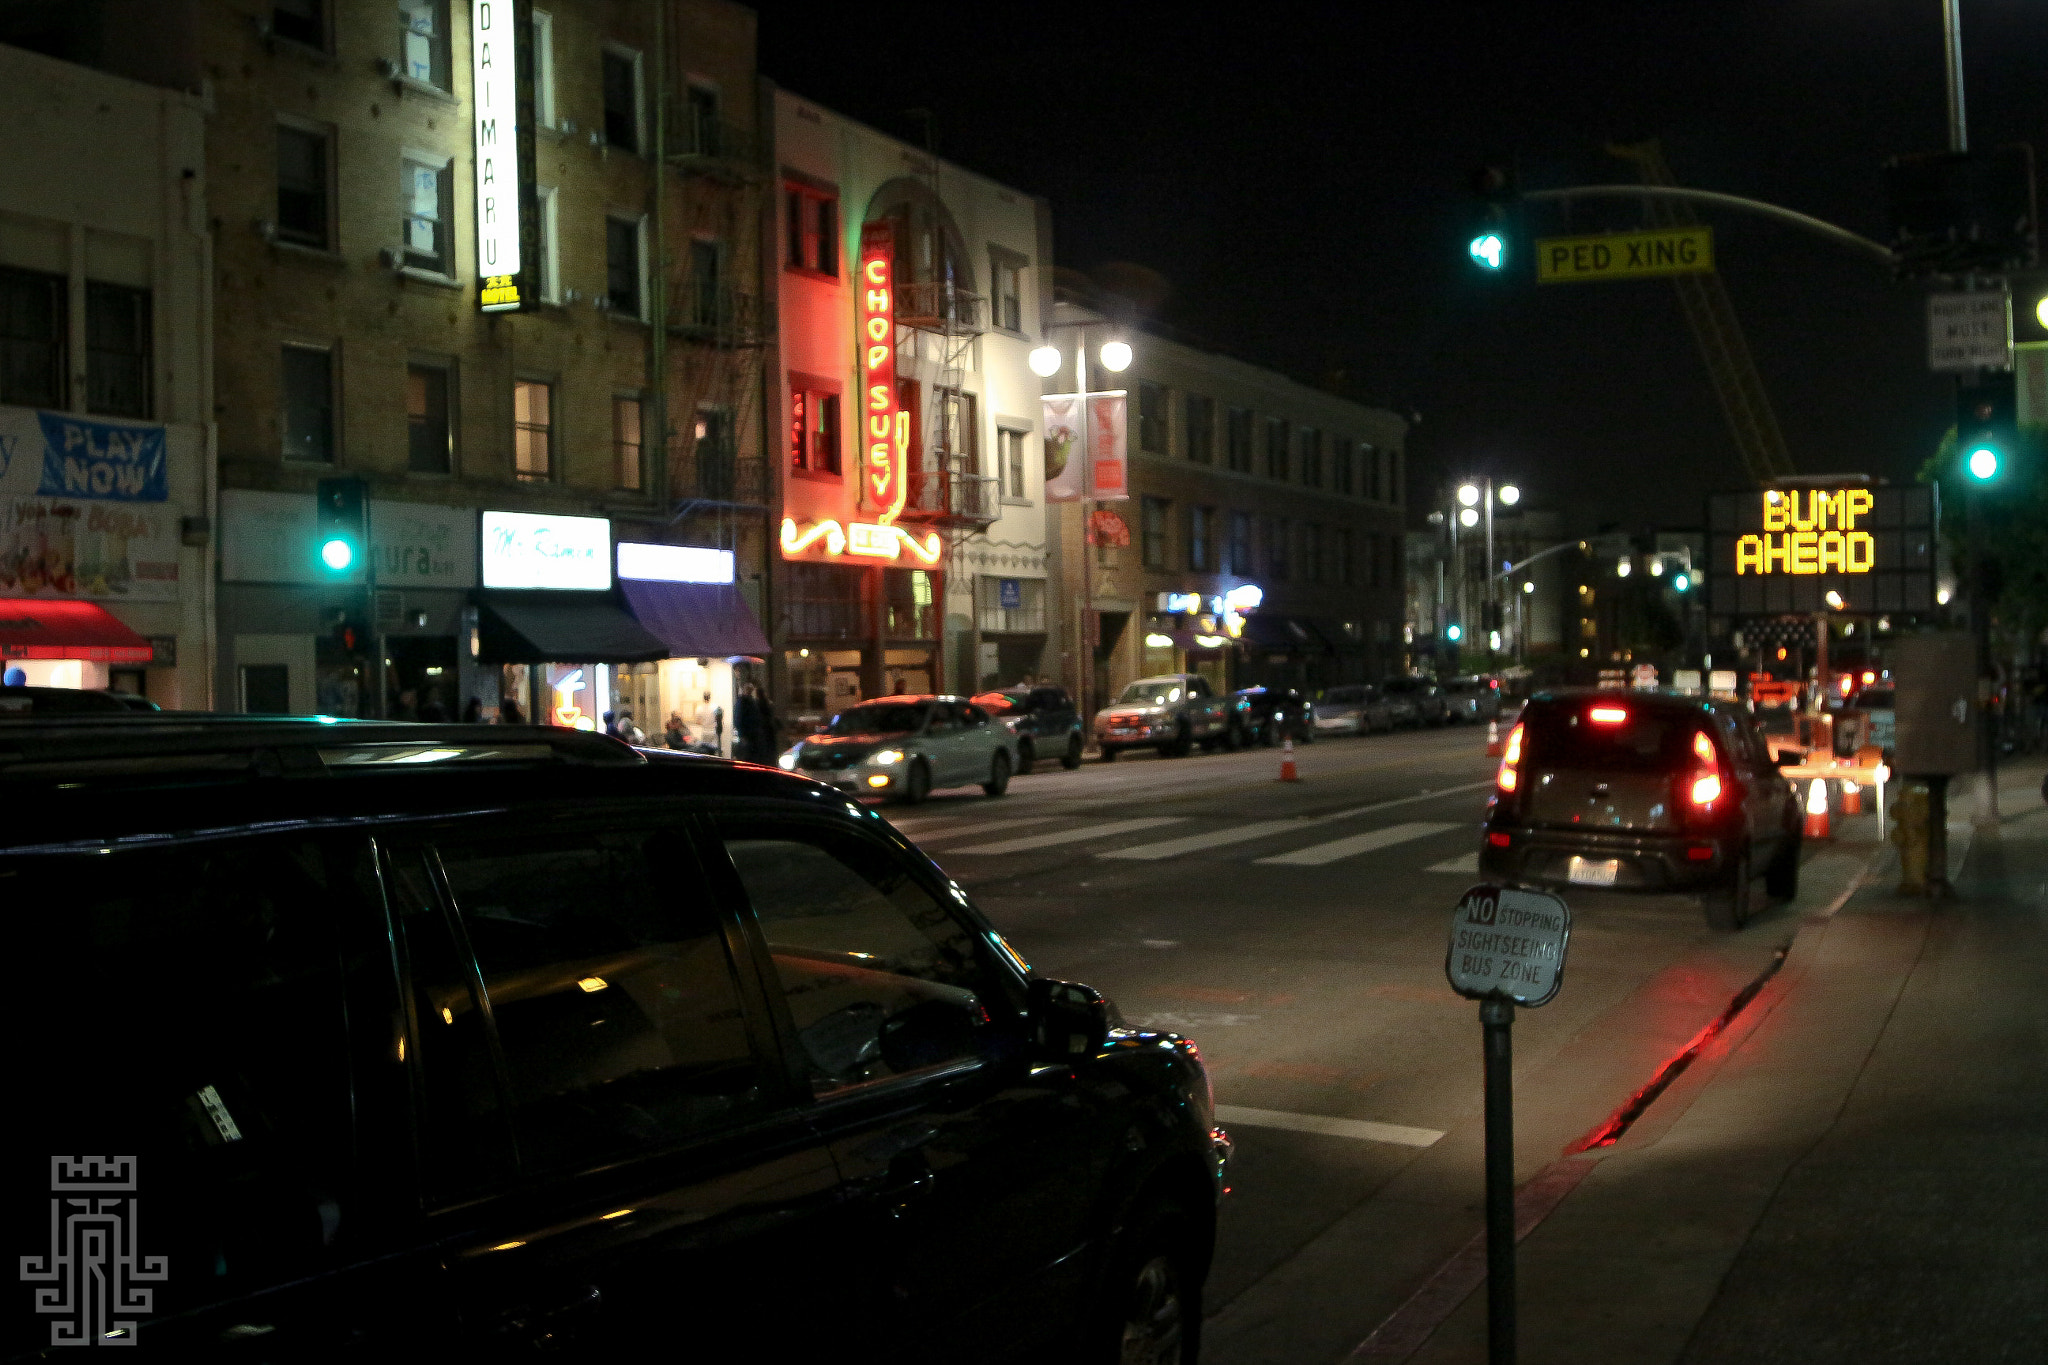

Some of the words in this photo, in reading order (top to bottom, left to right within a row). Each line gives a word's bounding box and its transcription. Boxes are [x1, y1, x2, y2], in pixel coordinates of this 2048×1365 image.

[480, 3, 496, 265] DAIMARU
[1552, 244, 1611, 273] PED
[1627, 237, 1697, 267] XING
[867, 260, 889, 369] CHOP
[64, 424, 145, 462] PLAY
[870, 385, 890, 495] SUEY
[63, 457, 146, 495] NOW
[1763, 489, 1874, 531] BUMP
[1736, 531, 1874, 575] AHEAD
[1467, 896, 1494, 922] NO
[1498, 908, 1562, 932] STOPPING
[1458, 930, 1556, 960] SIGHTSEEING
[1461, 955, 1493, 976] BUS
[1500, 960, 1542, 984] ZONE
